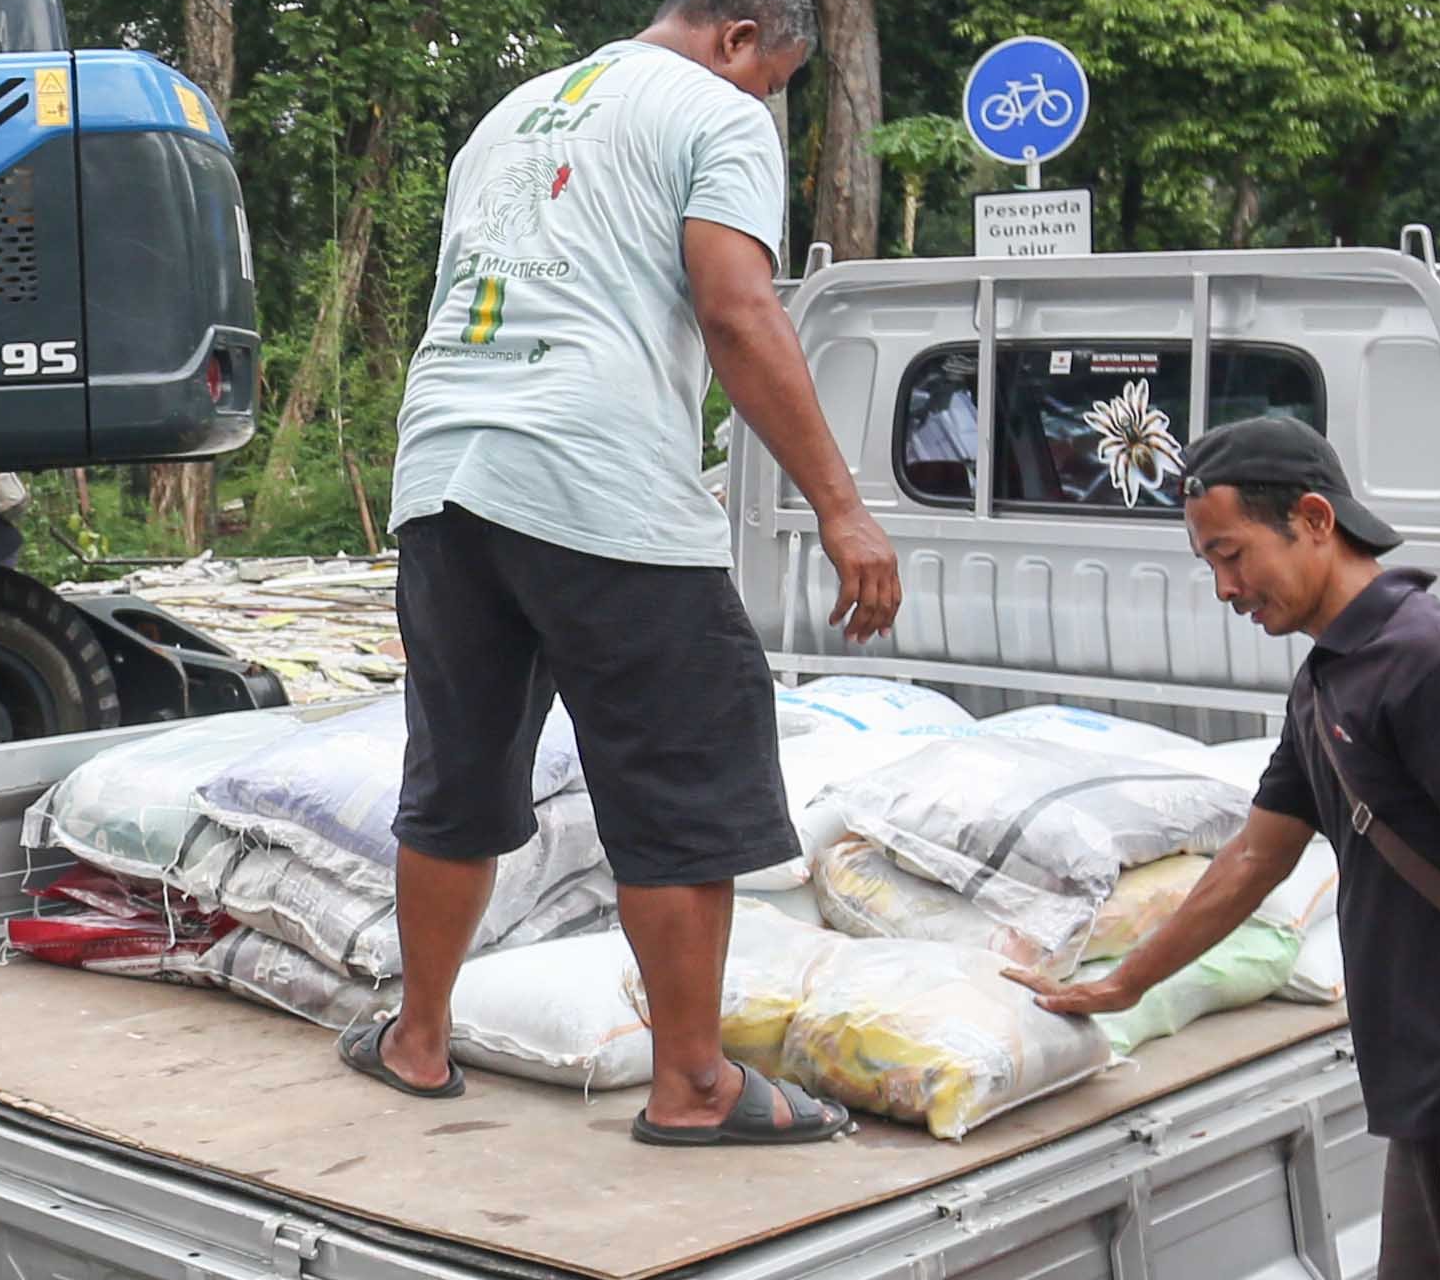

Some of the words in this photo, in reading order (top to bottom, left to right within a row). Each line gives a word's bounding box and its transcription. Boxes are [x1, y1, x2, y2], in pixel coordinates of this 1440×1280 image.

[983, 200, 1082, 220] Pesepeda
[989, 221, 1076, 238] Gunakan
[481, 256, 570, 279] MULTIFEED
